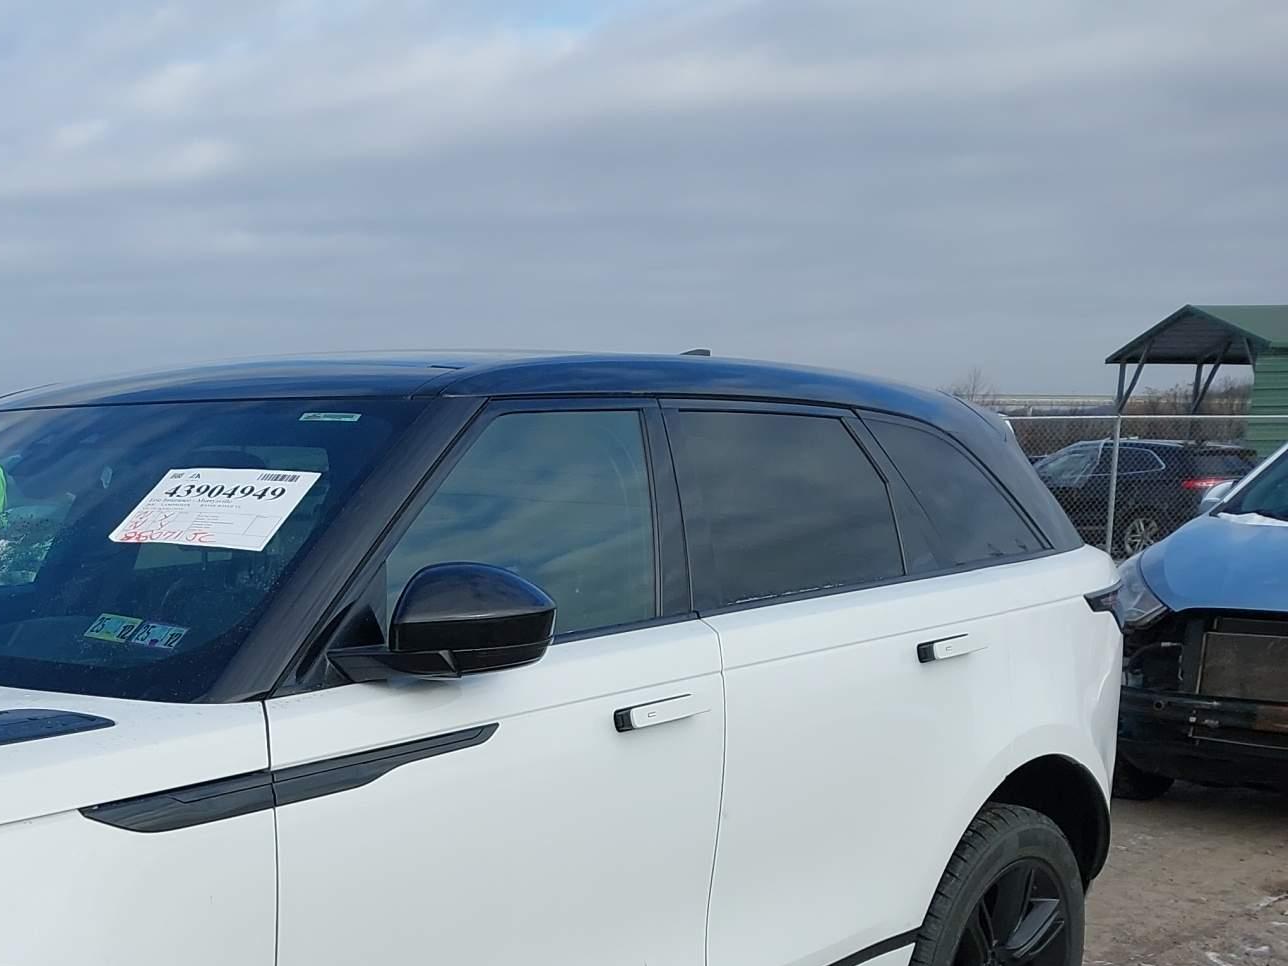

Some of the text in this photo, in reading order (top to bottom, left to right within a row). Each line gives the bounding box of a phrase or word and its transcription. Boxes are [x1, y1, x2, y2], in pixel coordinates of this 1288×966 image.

[164, 484, 288, 501] 43904949
[90, 617, 135, 640] 25 12
[136, 624, 183, 648] 25 12
